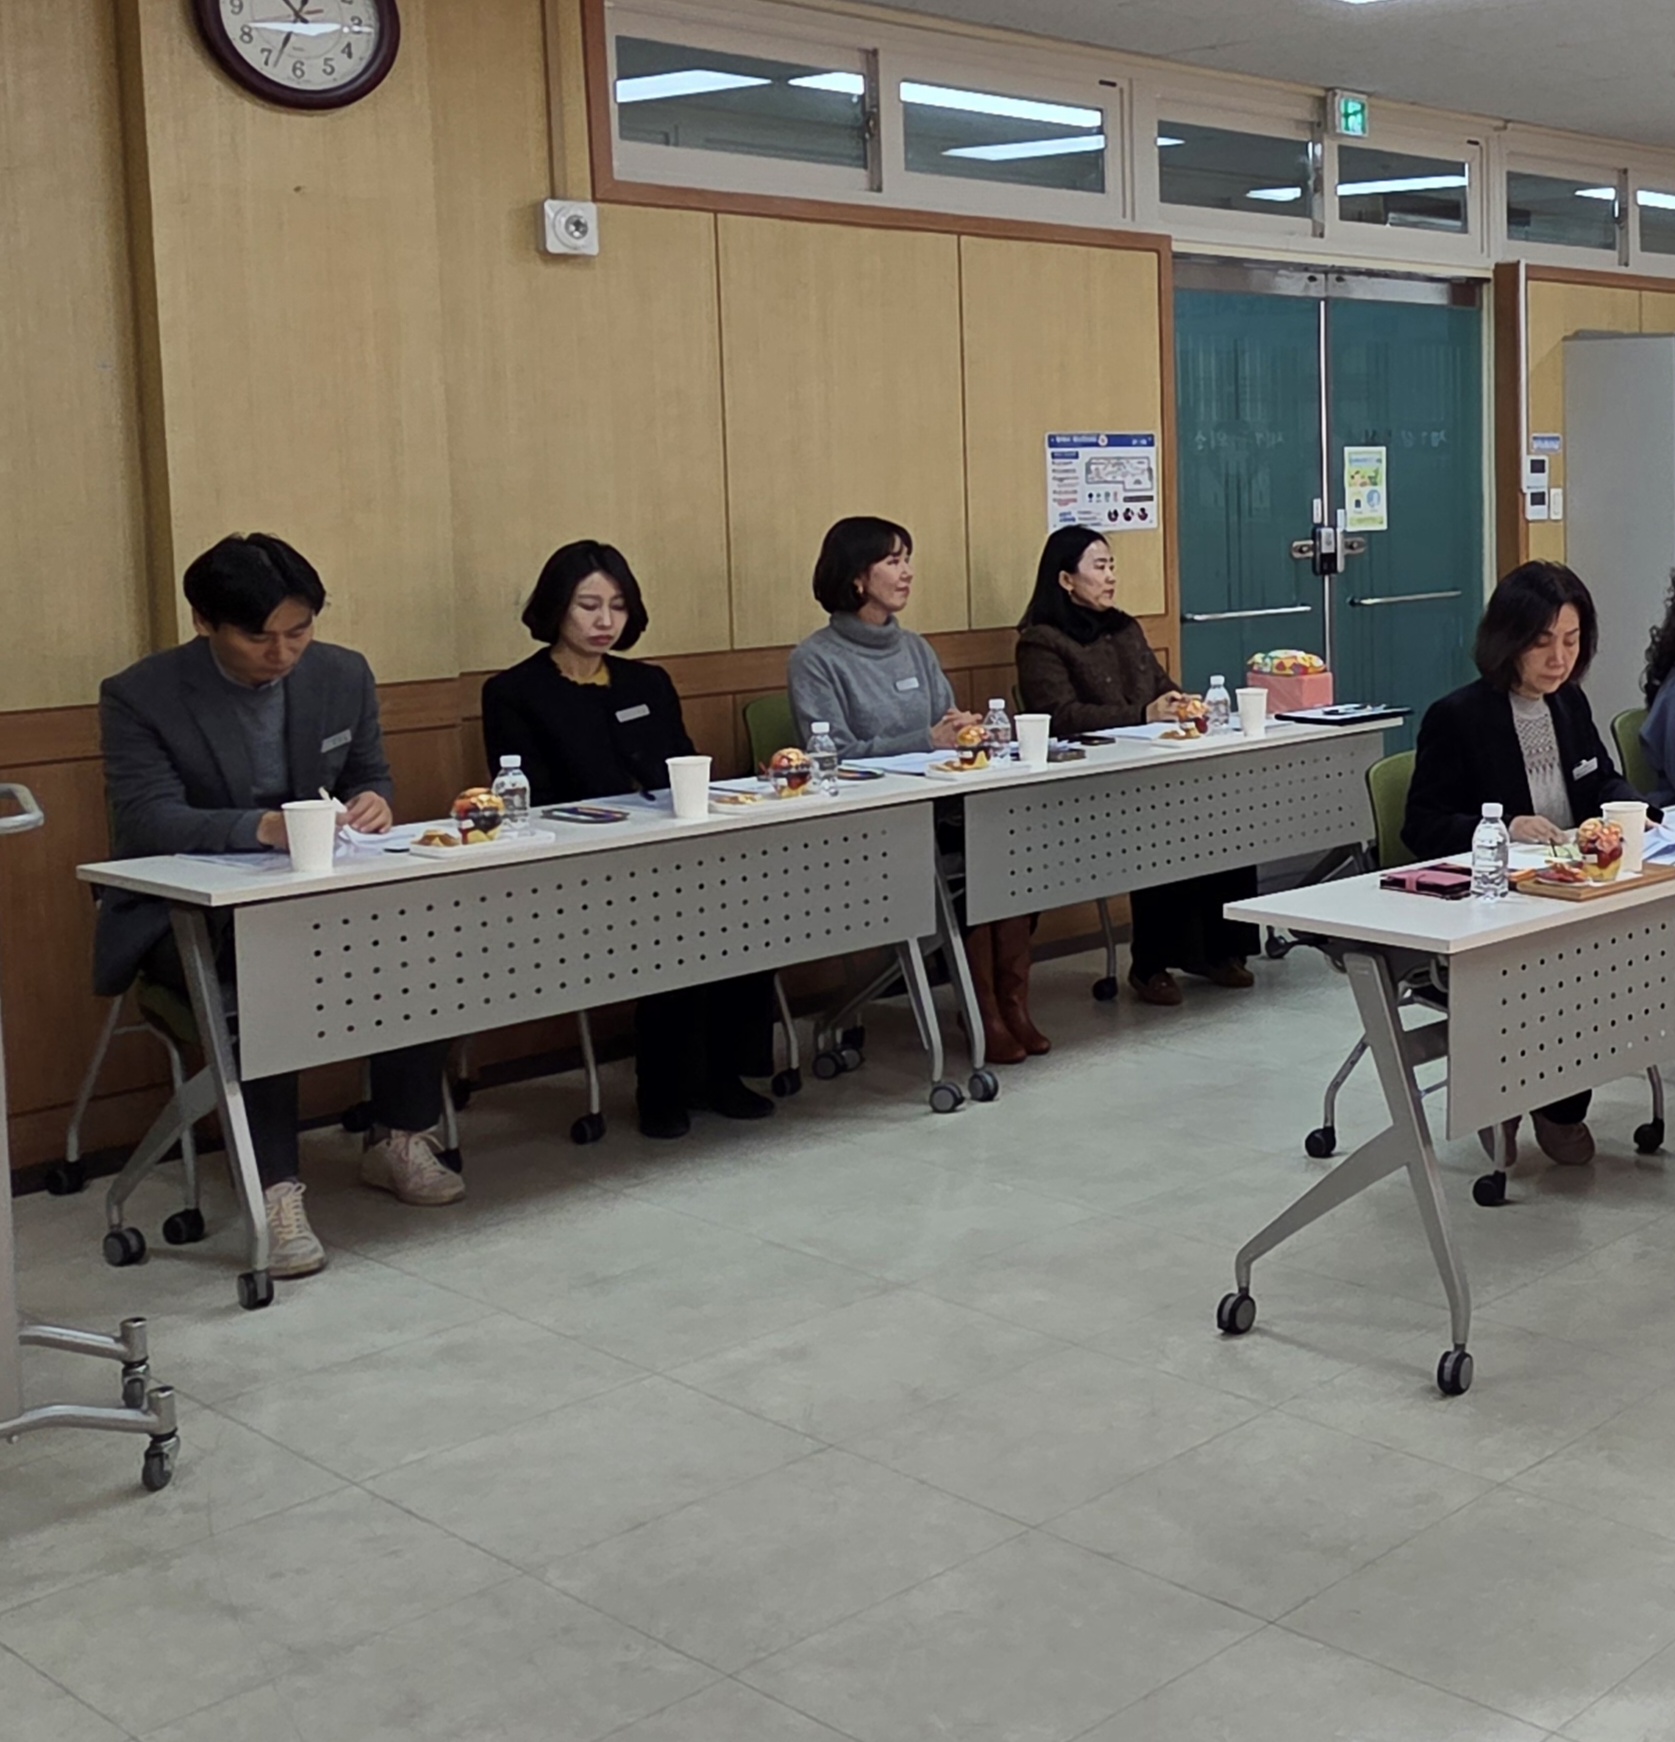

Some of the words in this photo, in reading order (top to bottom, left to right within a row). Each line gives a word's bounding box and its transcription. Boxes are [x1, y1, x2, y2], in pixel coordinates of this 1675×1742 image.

[229, 0, 244, 15] 9
[239, 23, 254, 44] 8
[260, 47, 273, 67] 7
[340, 41, 354, 60] 4
[291, 59, 306, 79] 6
[321, 57, 336, 76] 5
